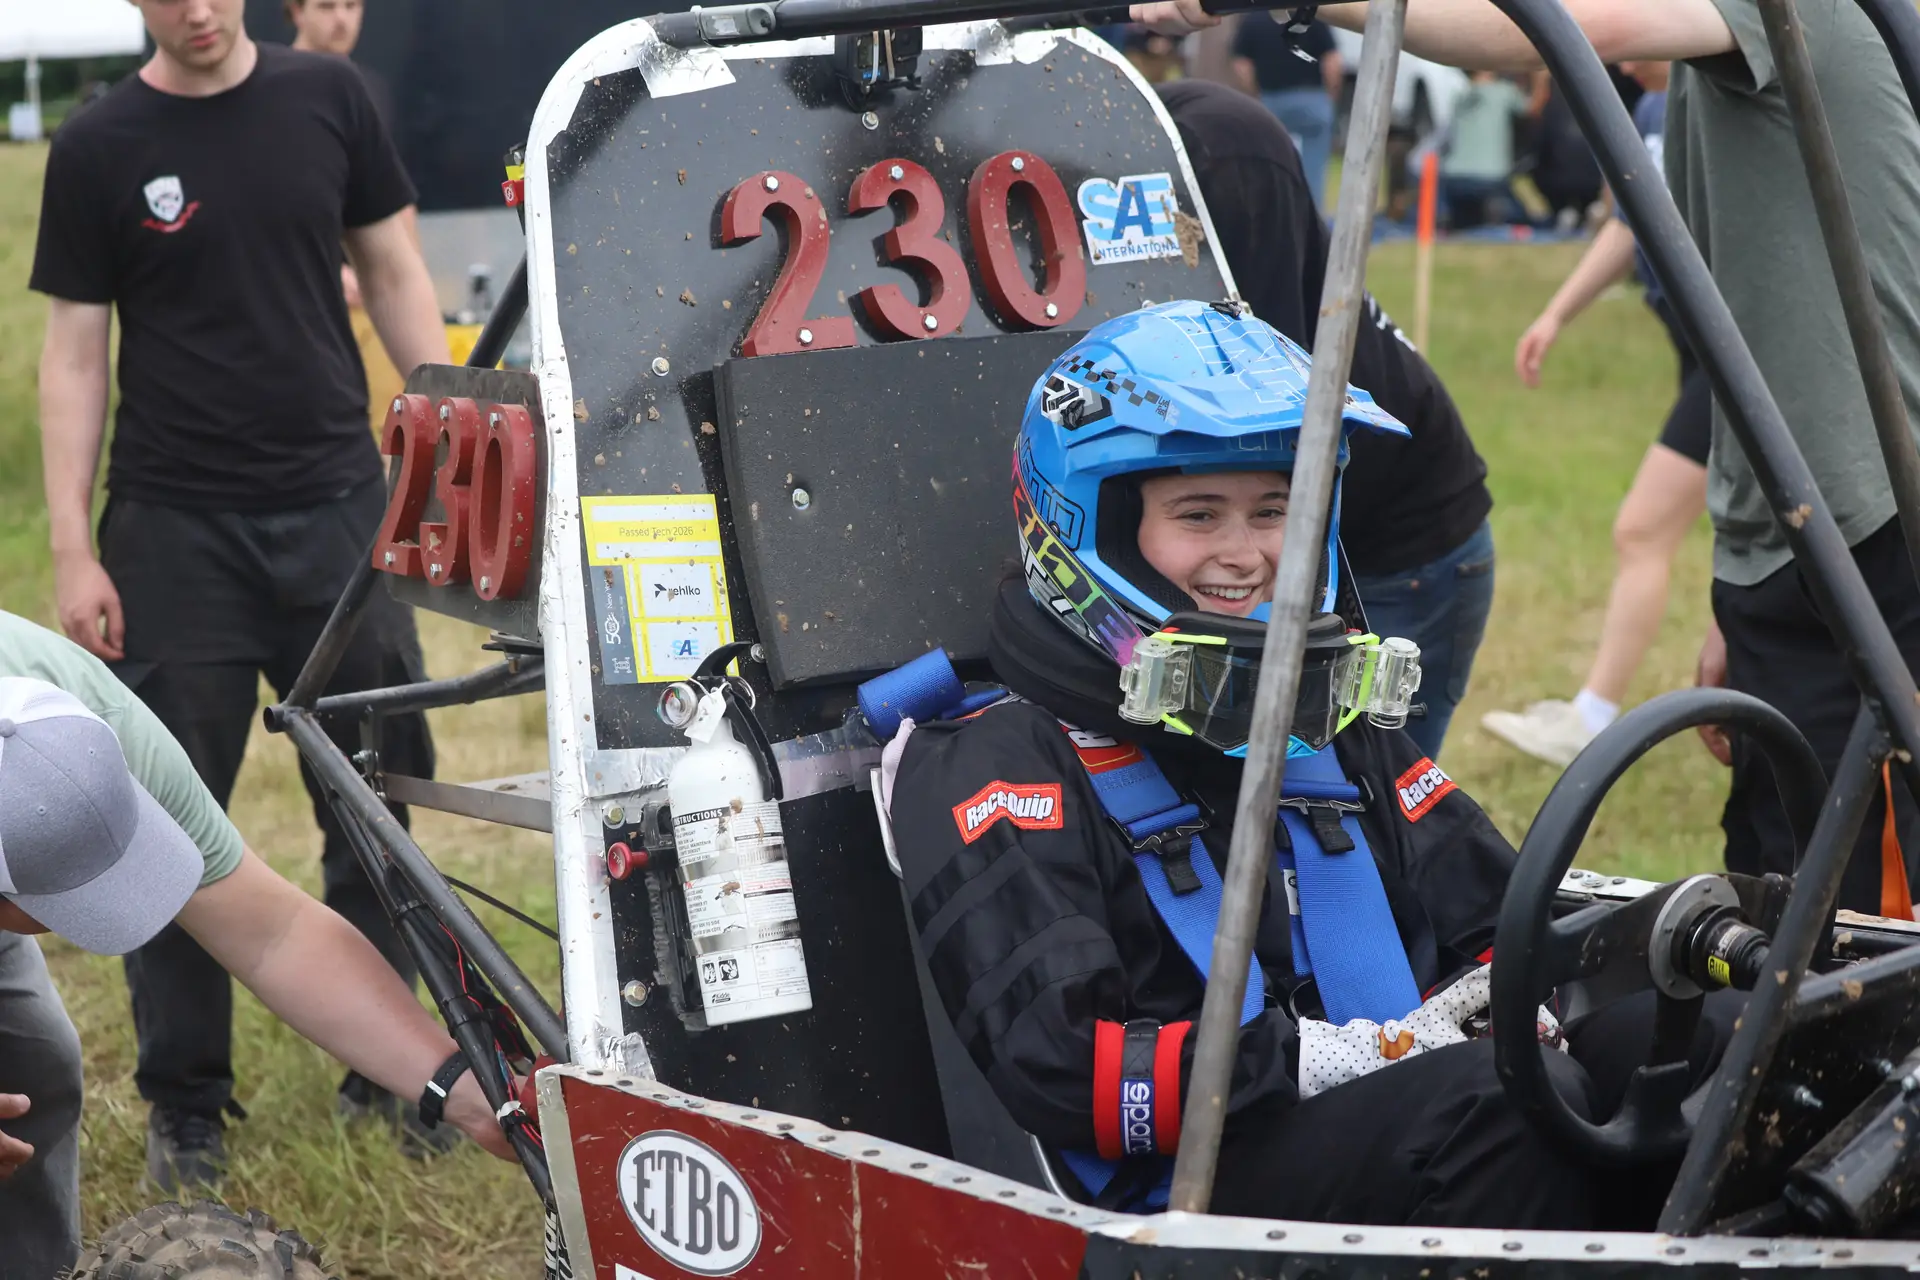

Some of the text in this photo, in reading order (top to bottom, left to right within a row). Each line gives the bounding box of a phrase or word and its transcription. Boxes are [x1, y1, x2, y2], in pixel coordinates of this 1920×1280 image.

[1082, 178, 1176, 240] SAE
[723, 150, 1087, 357] 230
[1095, 241, 1181, 259] NTERNATIONA
[372, 394, 536, 601] 230
[619, 526, 694, 537] Passed Tech 2026
[671, 639, 700, 656] SAE
[673, 808, 723, 826] NSTRUCTIONS
[966, 791, 1054, 832] RaceQuip
[632, 1149, 740, 1256] ETBO
